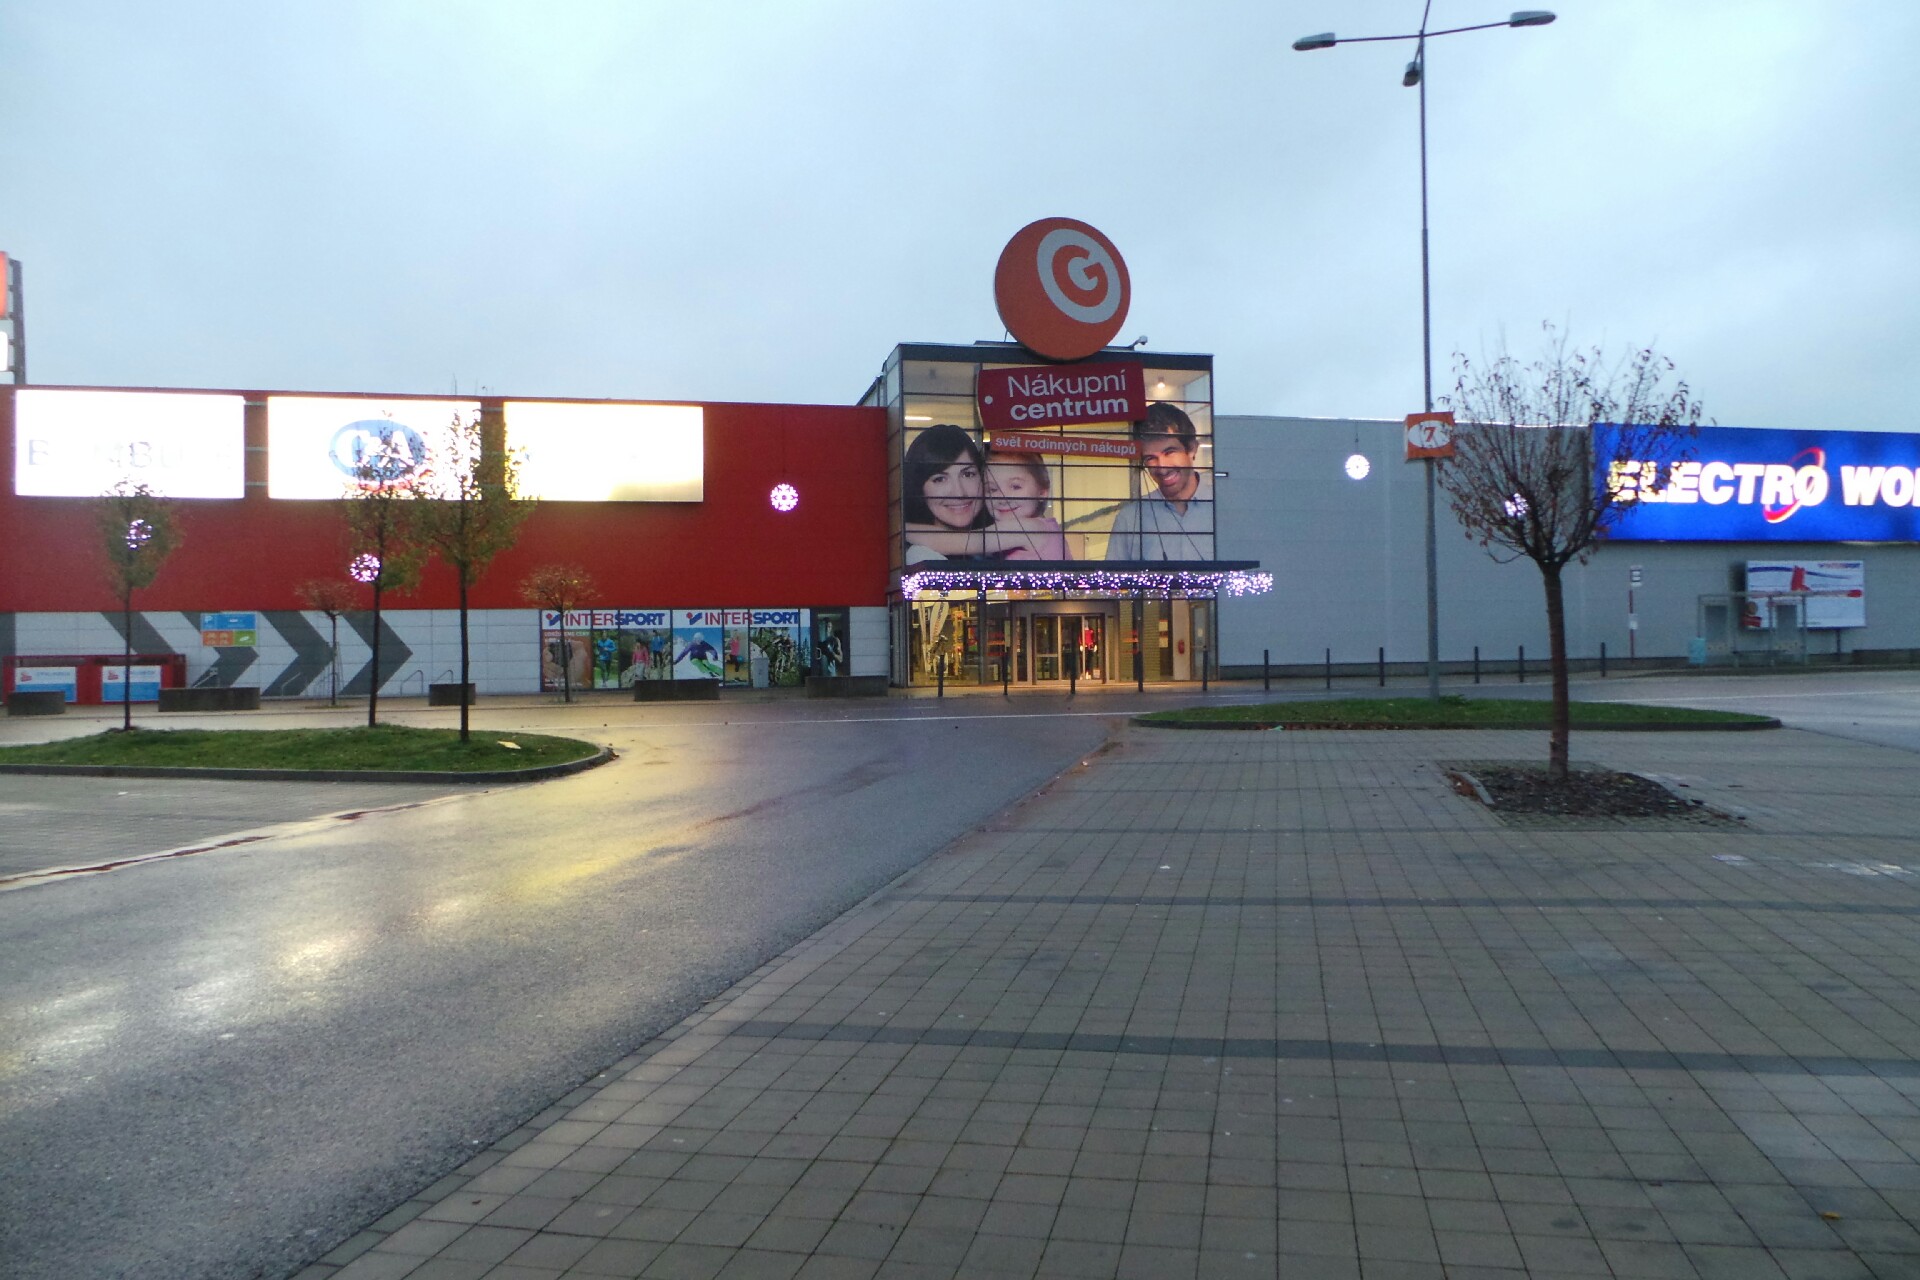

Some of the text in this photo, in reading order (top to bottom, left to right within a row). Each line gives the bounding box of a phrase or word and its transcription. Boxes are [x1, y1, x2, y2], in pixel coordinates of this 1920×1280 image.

[1051, 244, 1108, 307] G
[1007, 369, 1126, 397] Nákupní
[1010, 397, 1129, 421] centrum
[995, 435, 1136, 455] svět rodinných nákupů
[1423, 426, 1438, 442] 7
[334, 429, 416, 468] C&A
[1607, 460, 1829, 507] ELECTRO
[565, 612, 665, 626] INTERSPORT
[704, 611, 800, 625] INTERSPORT
